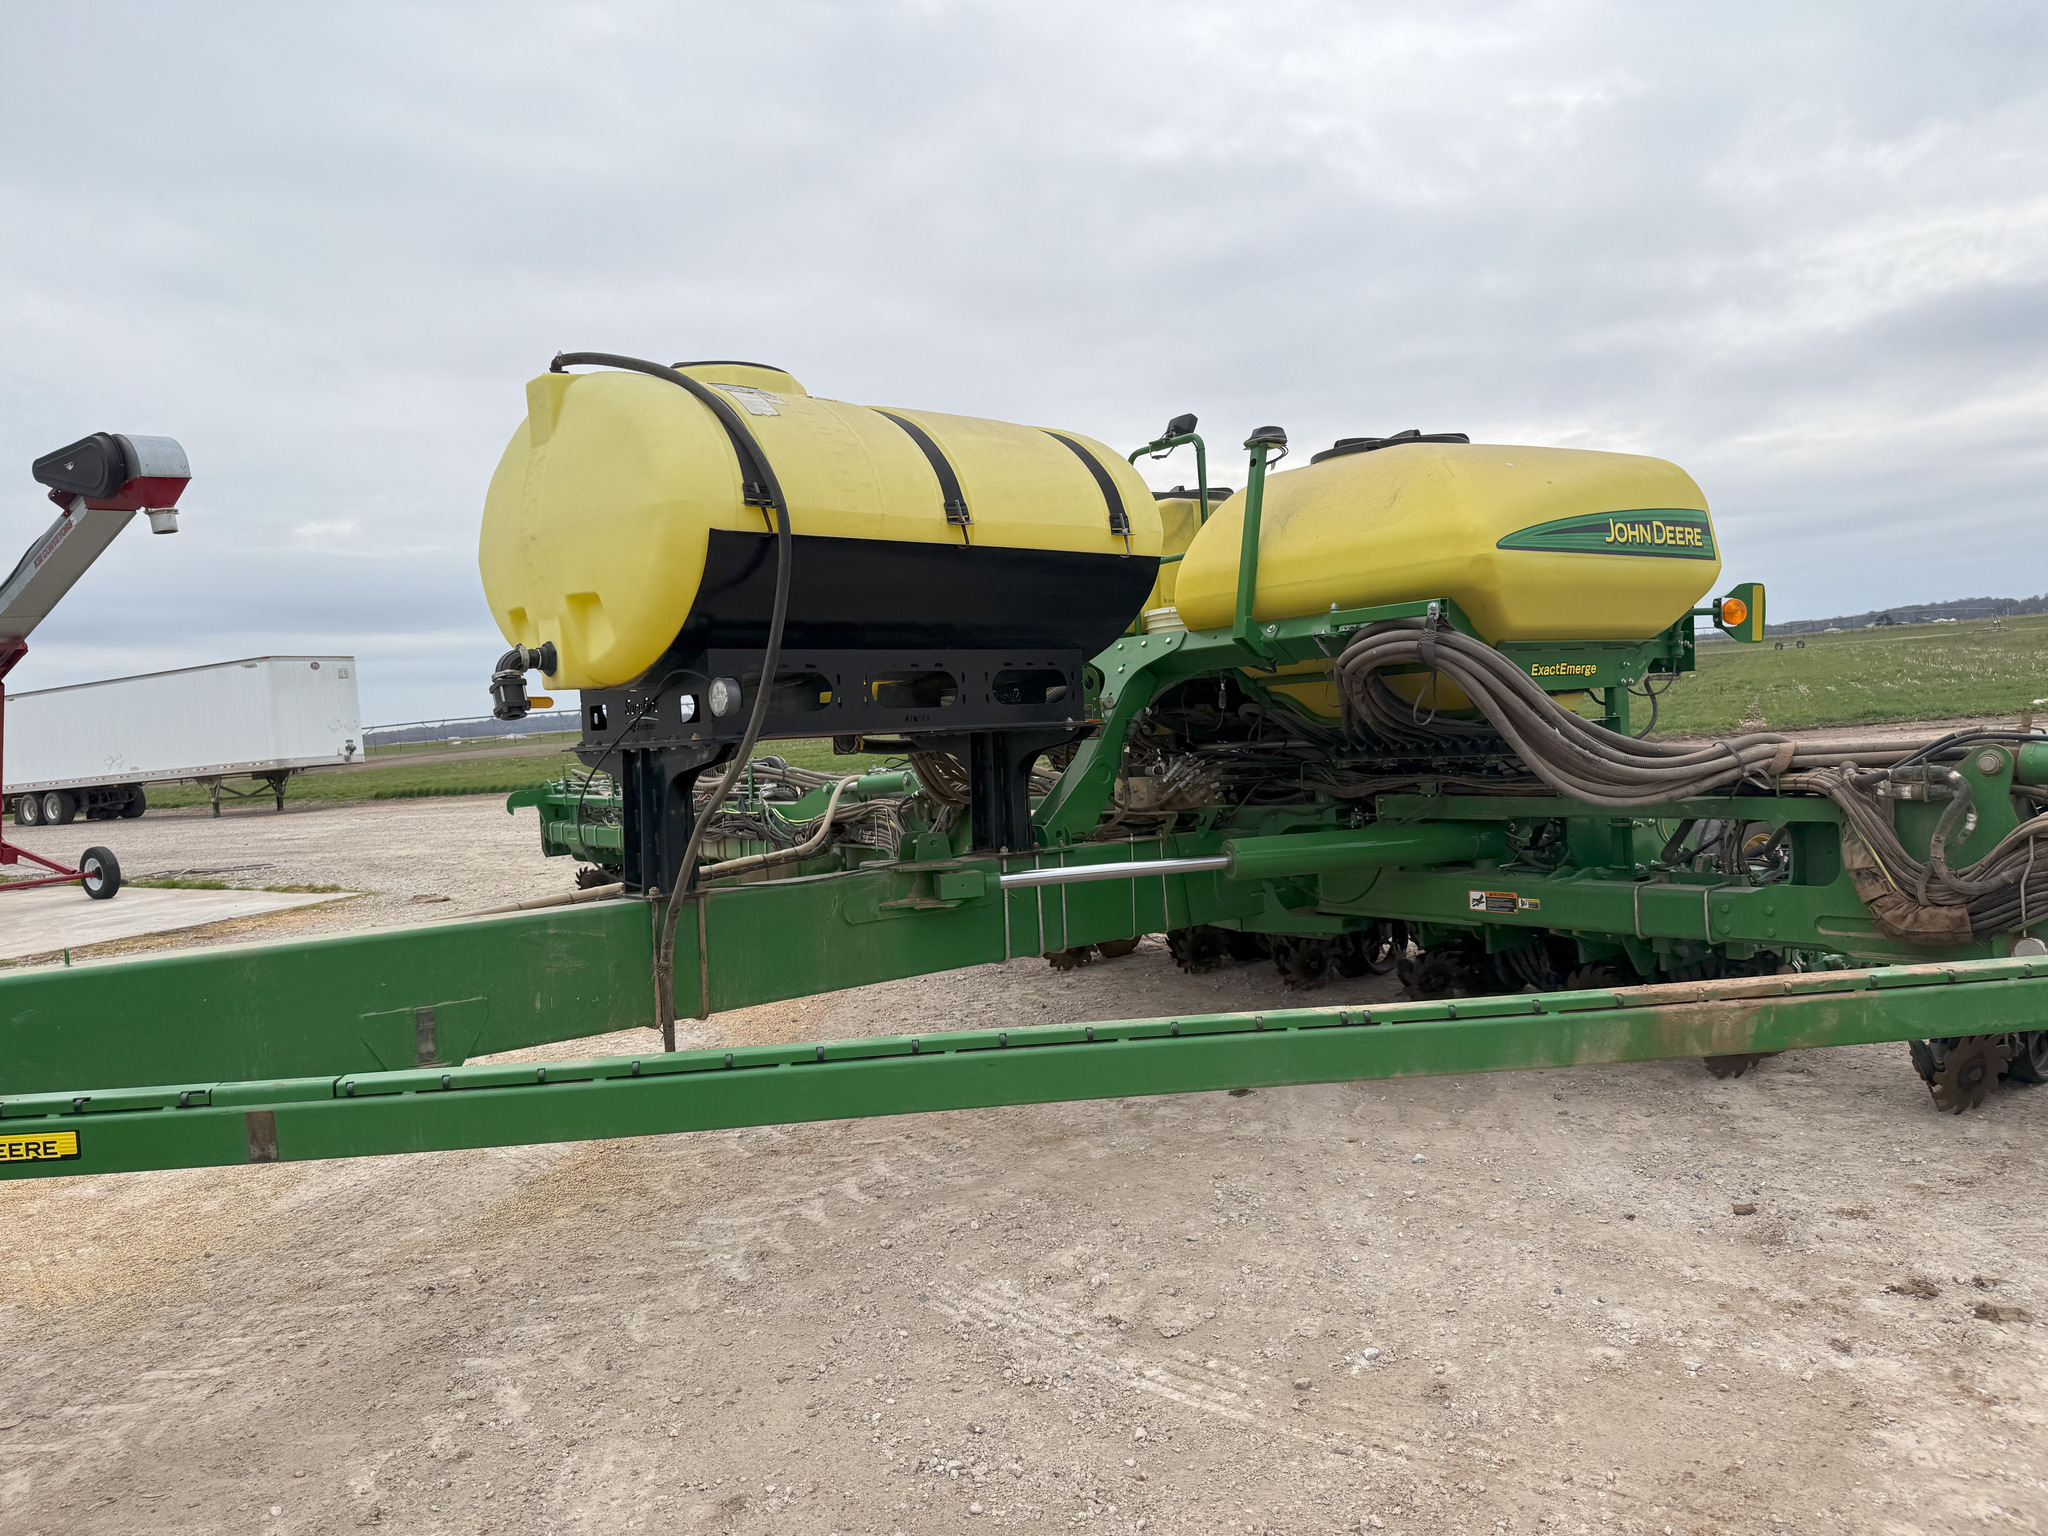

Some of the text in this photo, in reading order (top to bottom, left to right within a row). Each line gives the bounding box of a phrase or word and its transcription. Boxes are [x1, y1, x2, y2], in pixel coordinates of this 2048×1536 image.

[1605, 518, 1703, 547] JOHN DEERE
[1531, 662, 1597, 677] ExactEmerge
